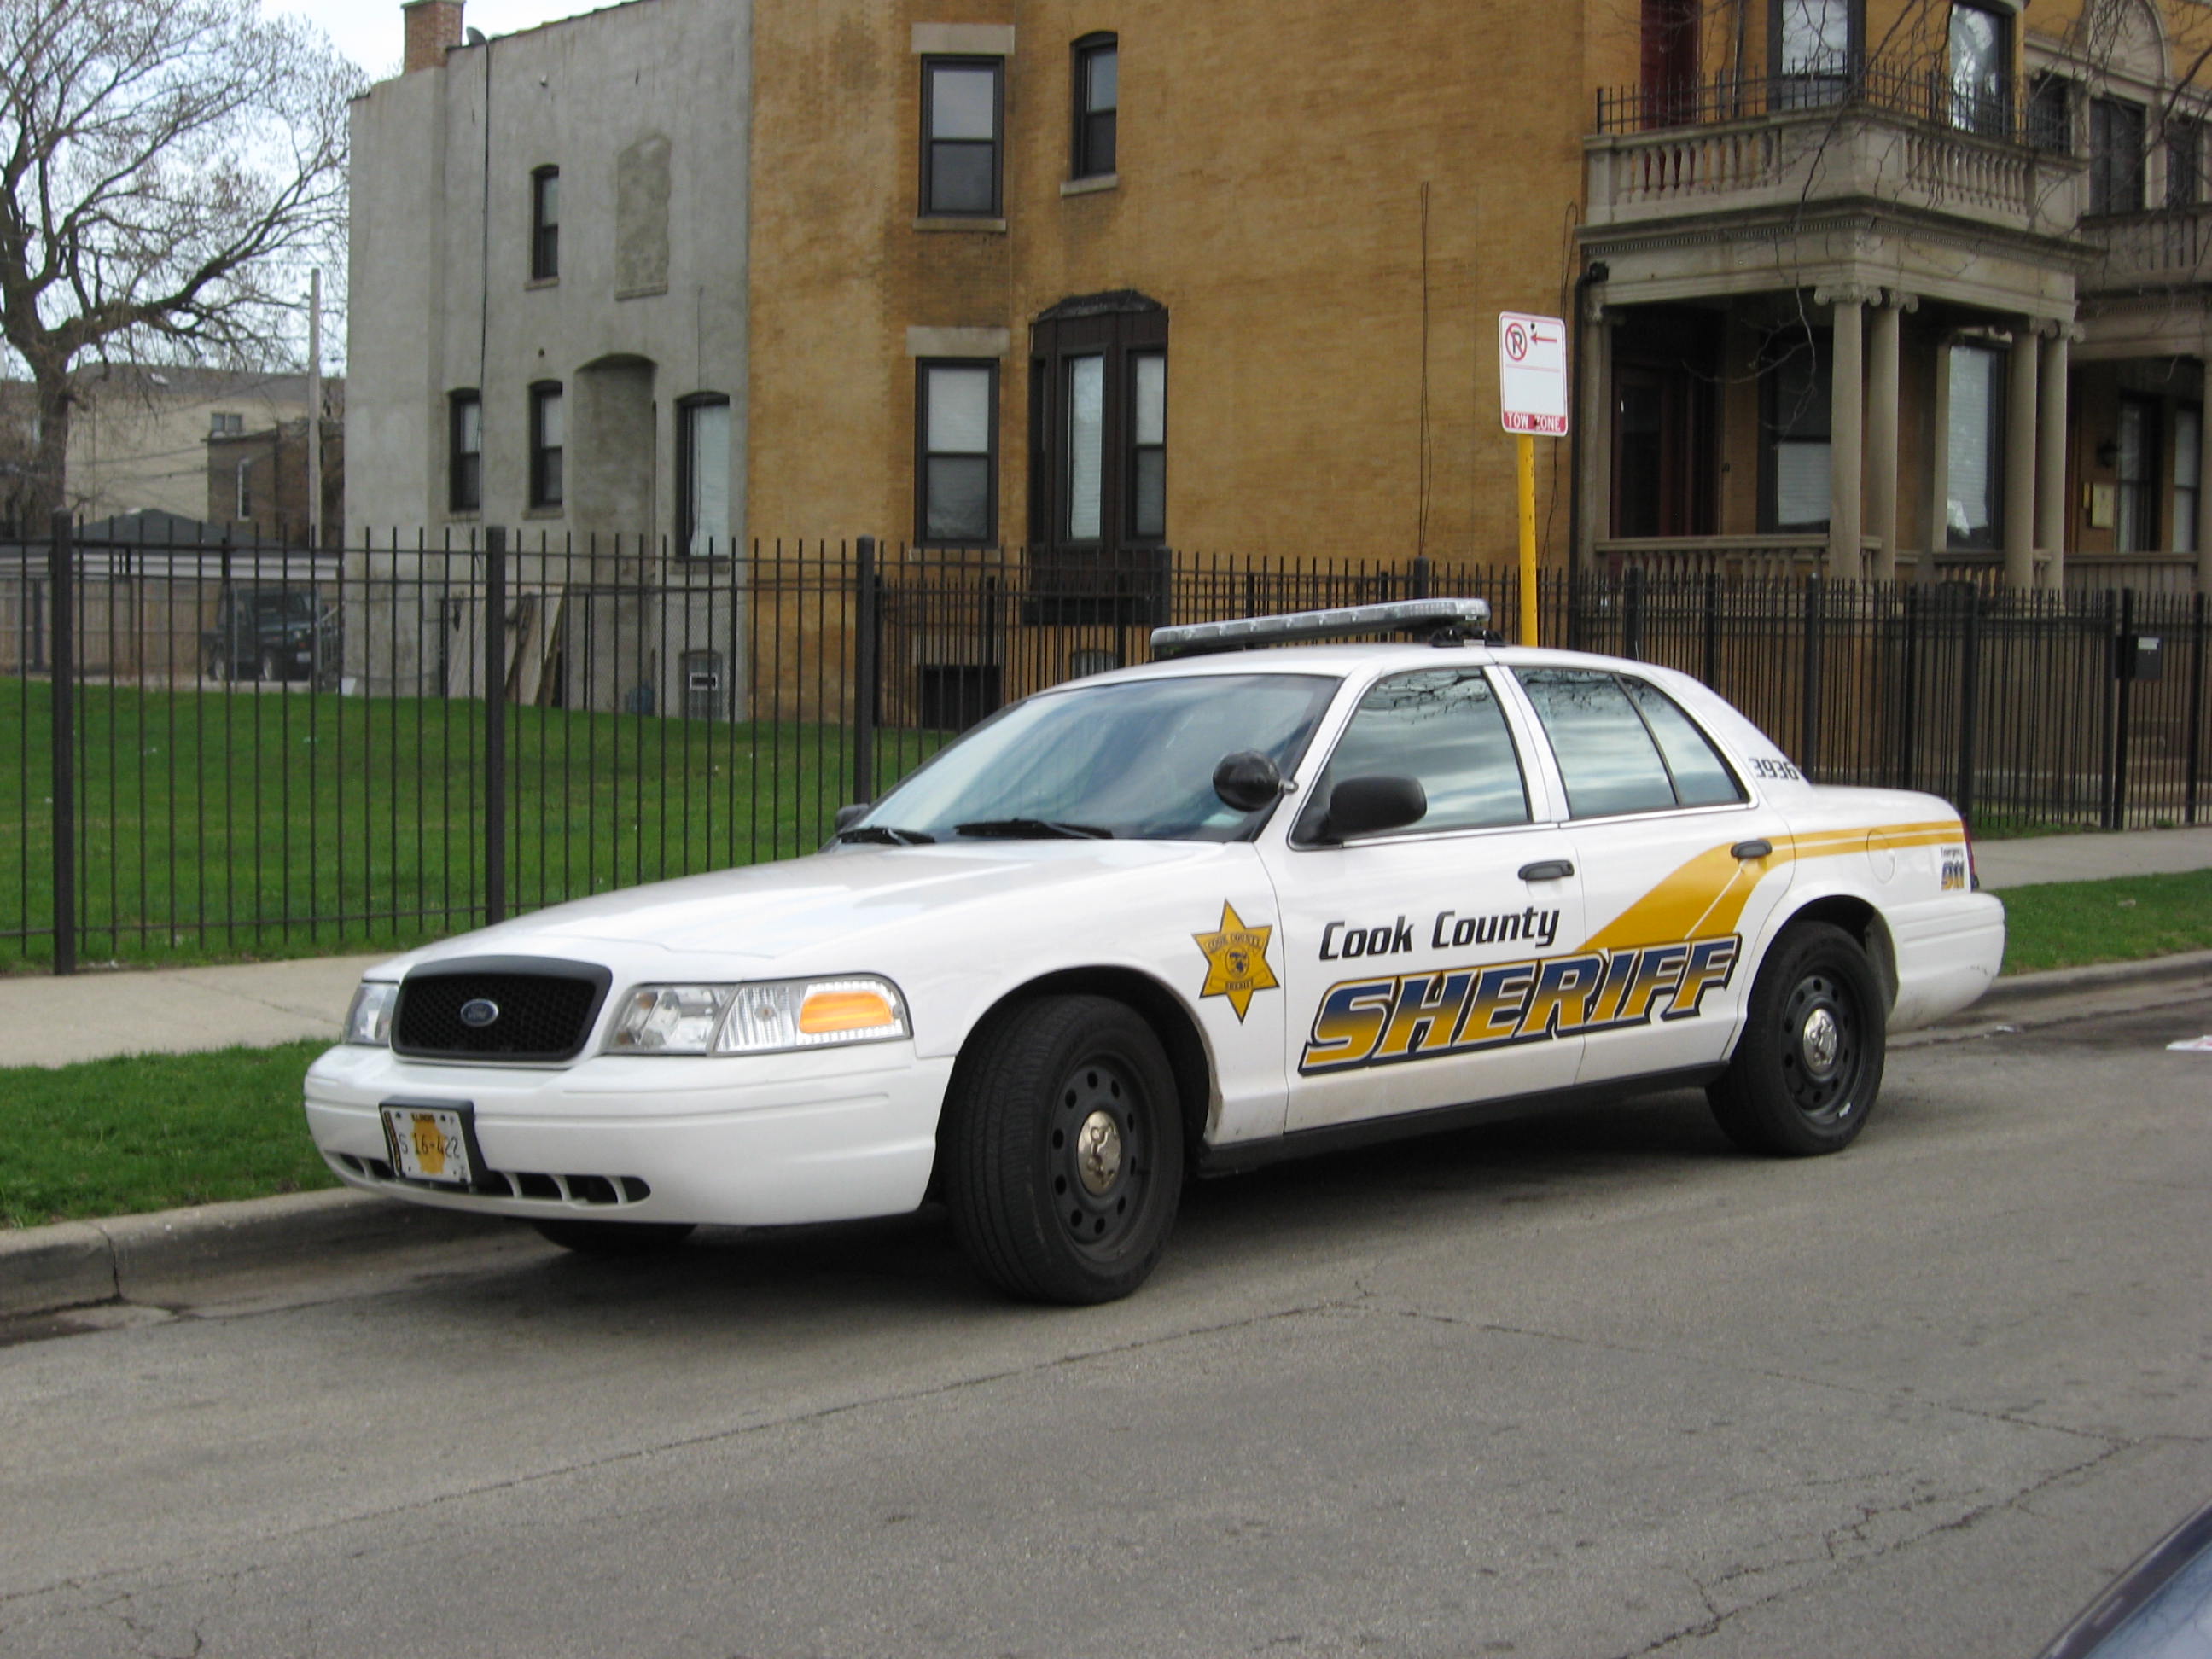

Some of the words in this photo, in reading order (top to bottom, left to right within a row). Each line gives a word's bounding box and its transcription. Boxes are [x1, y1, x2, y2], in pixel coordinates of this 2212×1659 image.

[1508, 411, 1529, 429] TOW
[1534, 415, 1561, 432] ZONE
[1748, 757, 1800, 781] 3936
[1941, 860, 1965, 891] 911
[1319, 915, 1414, 961] Cook
[1432, 906, 1560, 949] County
[1298, 933, 1742, 1077] SHERIFF
